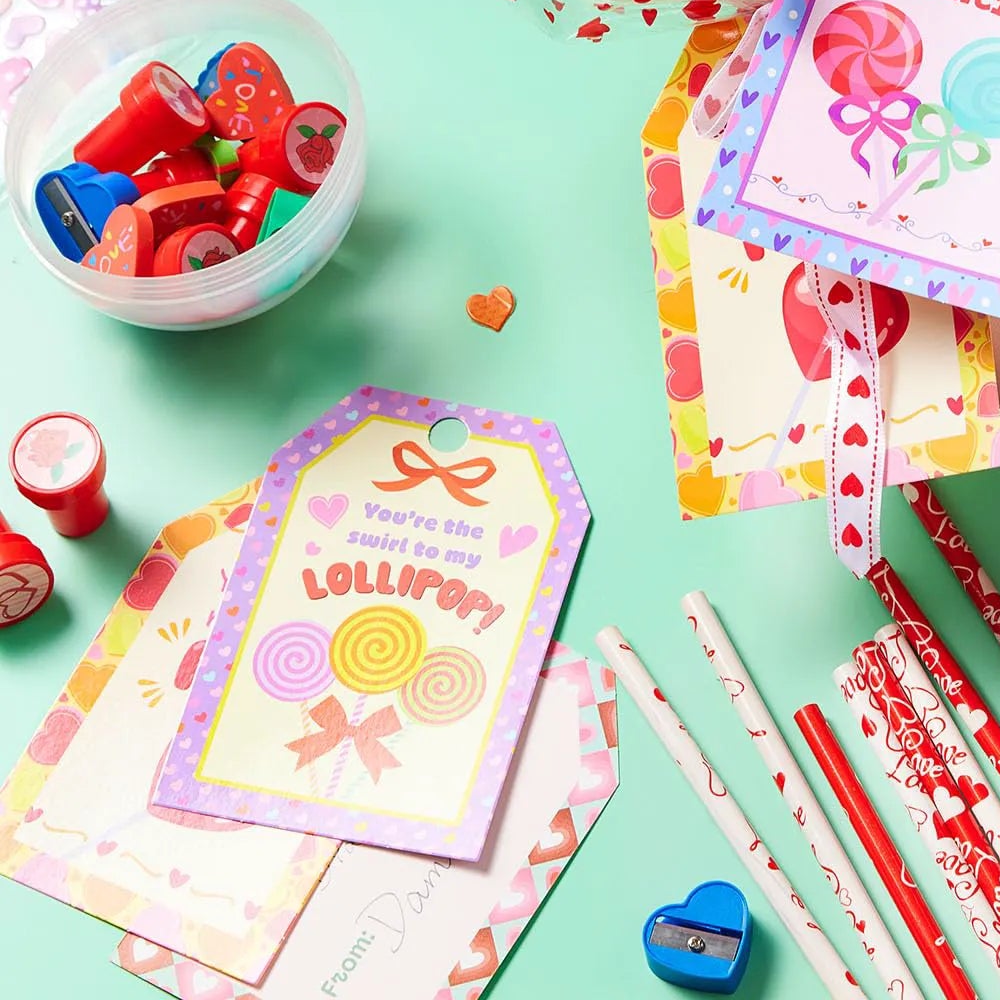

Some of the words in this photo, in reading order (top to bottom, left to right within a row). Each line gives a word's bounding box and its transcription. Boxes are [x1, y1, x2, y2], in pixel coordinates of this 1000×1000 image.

[364, 502, 439, 532] You're
[443, 518, 485, 540] the
[346, 530, 409, 554] swirl
[413, 541, 440, 560] to
[443, 548, 482, 570] my
[301, 560, 506, 636] LOLLIPOP!
[320, 930, 376, 998] From:
